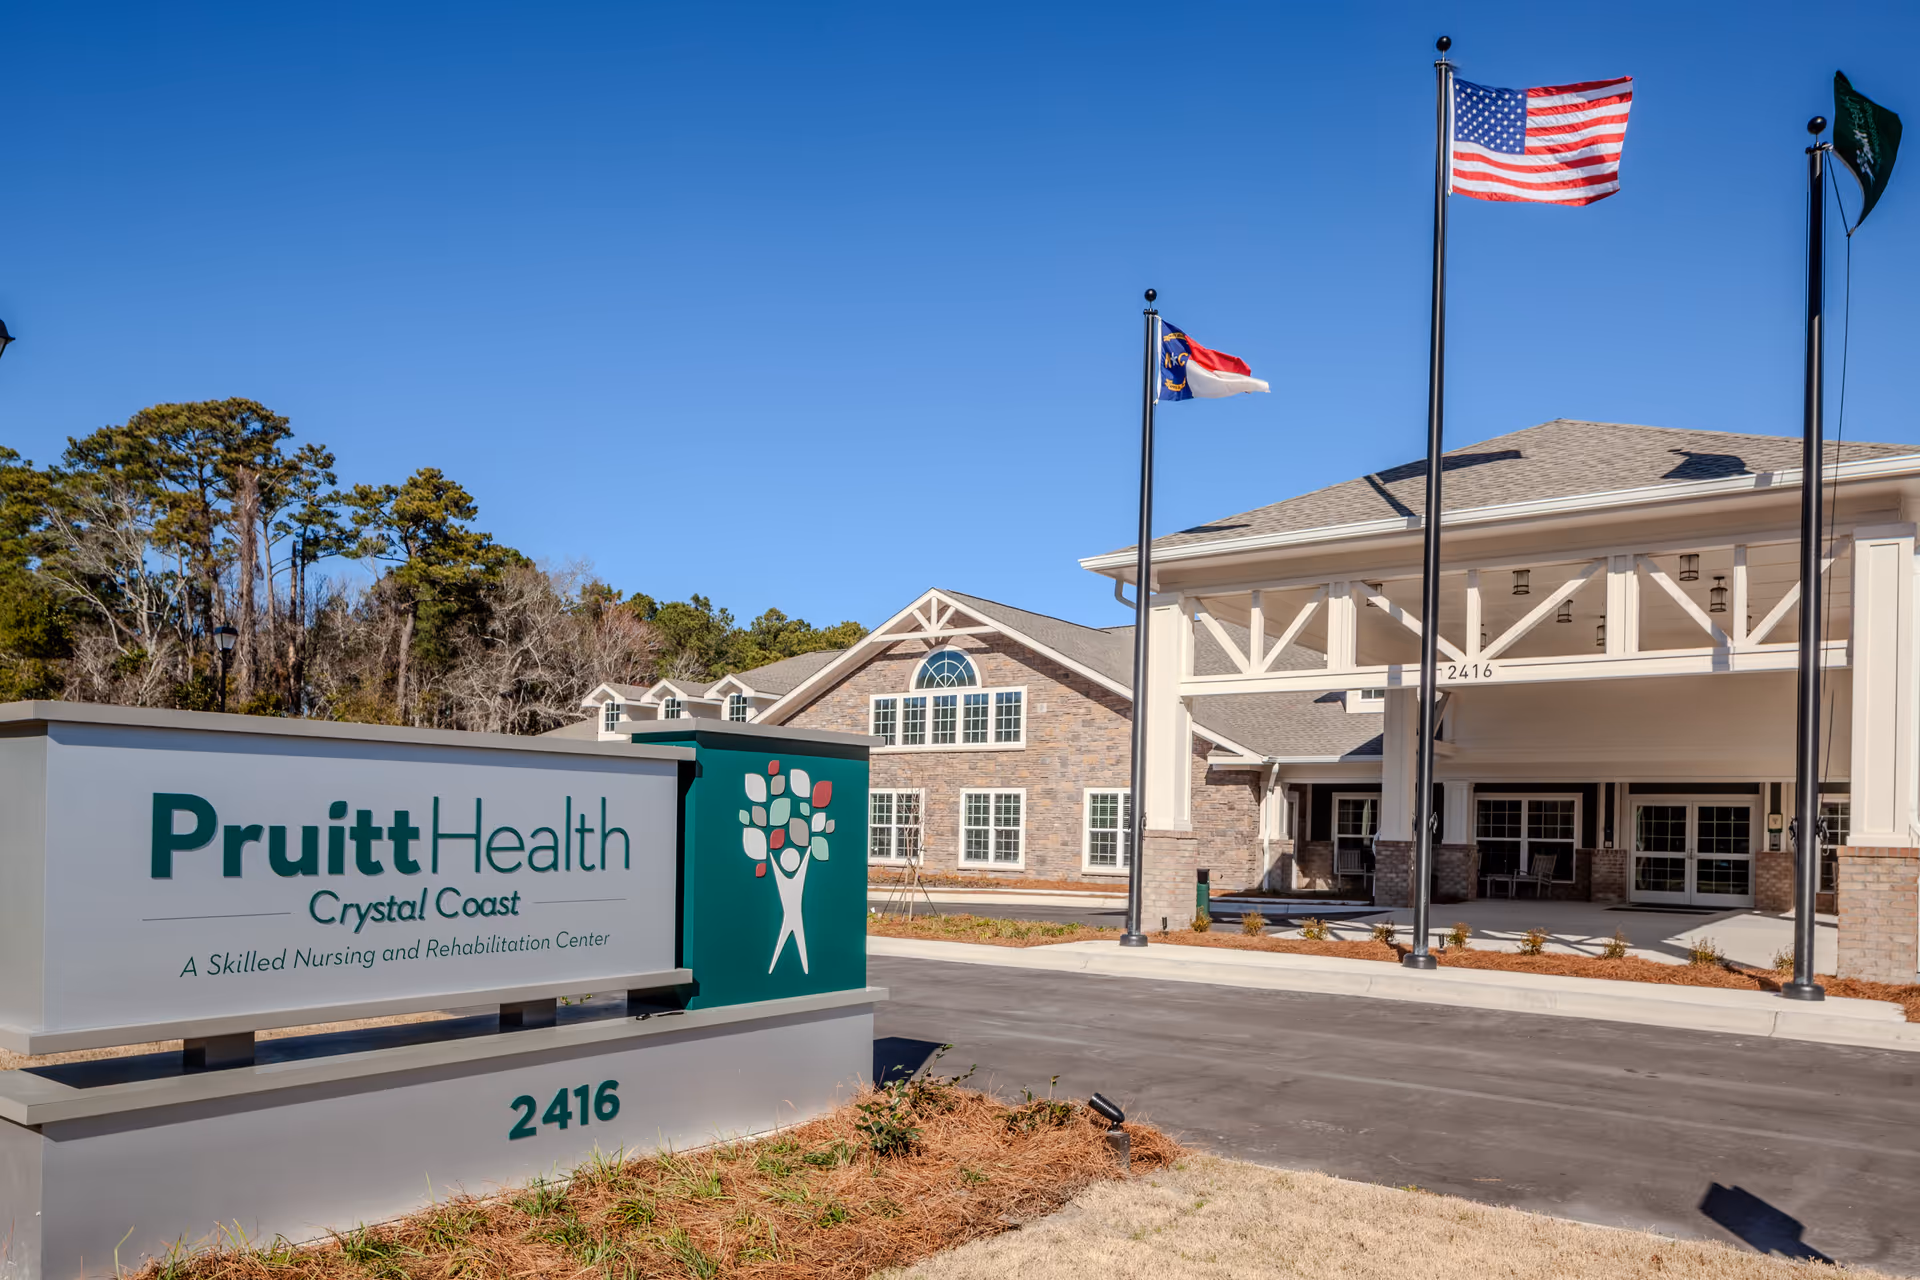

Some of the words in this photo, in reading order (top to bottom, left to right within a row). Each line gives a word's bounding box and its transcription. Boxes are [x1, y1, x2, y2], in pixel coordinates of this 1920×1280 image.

[1447, 663, 1493, 680] 2416
[150, 791, 631, 880] PruittHealth
[308, 887, 429, 935] Crystal
[434, 886, 522, 920] Coast
[179, 956, 199, 979] A
[206, 947, 288, 976] Skilled
[293, 946, 377, 969] Nursing
[382, 938, 421, 962] and
[425, 934, 551, 959] Rehabilitation
[555, 930, 611, 949] Center
[508, 1079, 622, 1141] 2416
